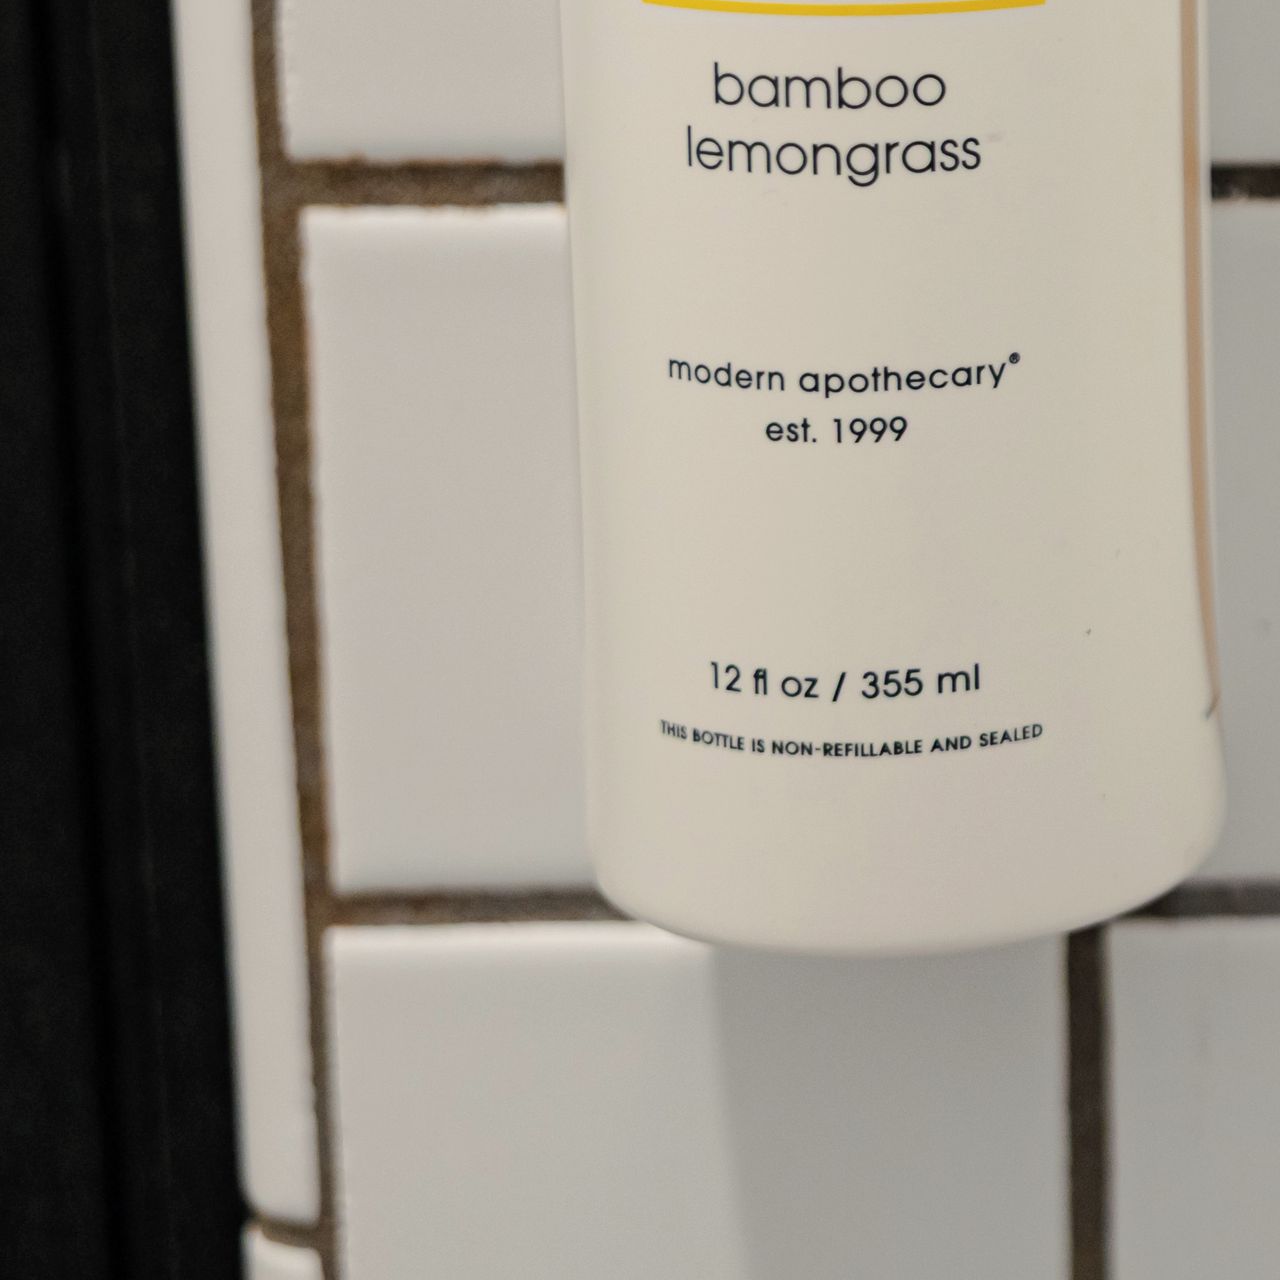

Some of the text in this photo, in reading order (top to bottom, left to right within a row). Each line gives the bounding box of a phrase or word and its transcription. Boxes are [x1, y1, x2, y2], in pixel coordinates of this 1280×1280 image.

[713, 61, 947, 110] bamboo
[687, 125, 981, 188] lemongrass
[668, 359, 785, 391] modern
[765, 416, 908, 444] est. 1999
[710, 661, 980, 702] 12 fl oz / 355 ml
[660, 720, 1043, 758] THIS BOTTLE IS NON-REFILLABLE AND SEALED
